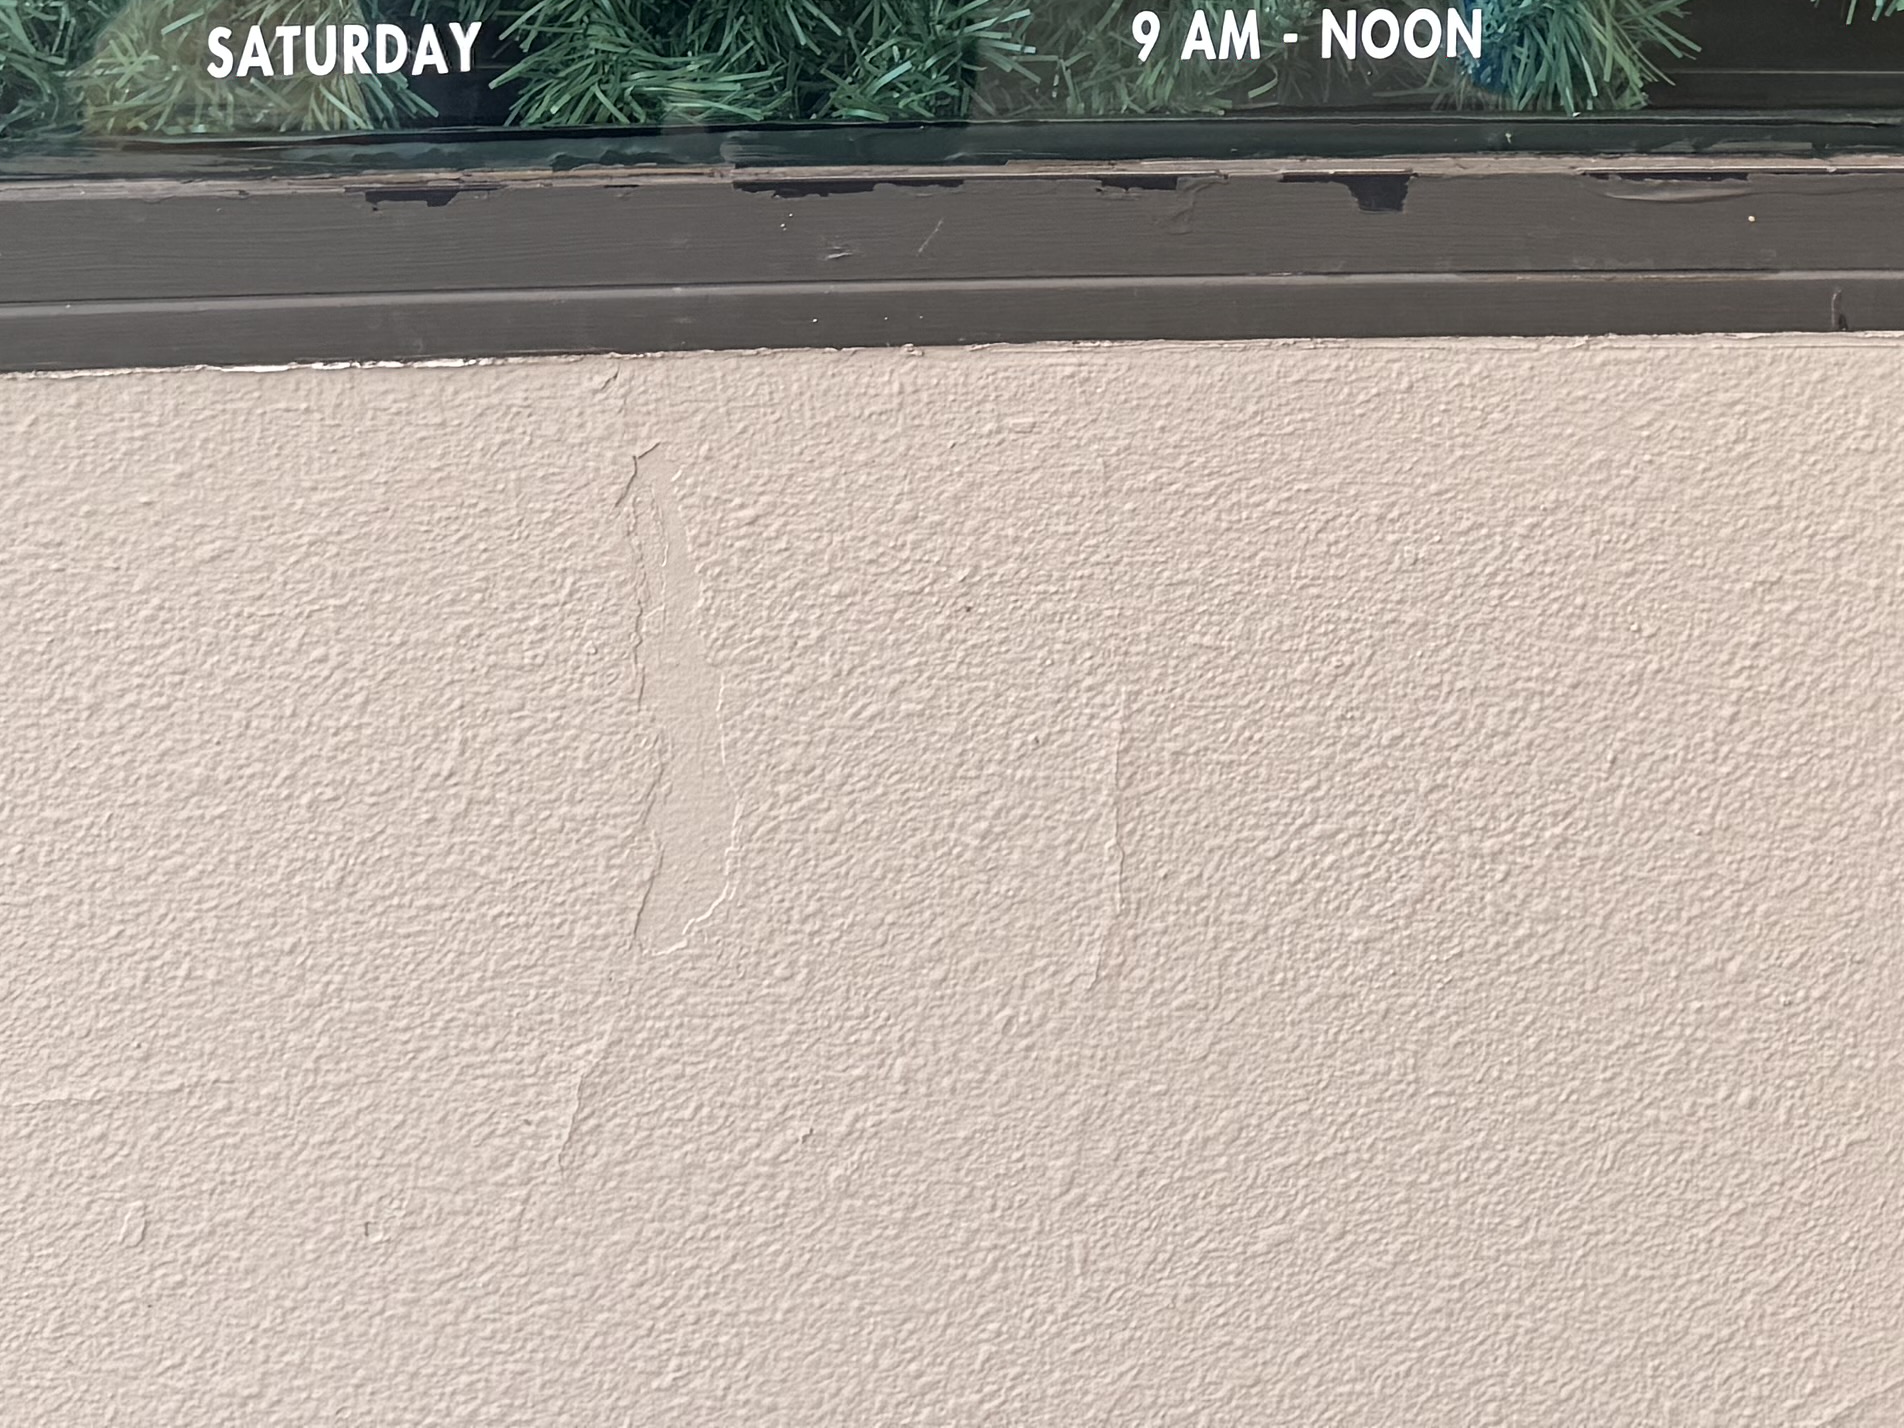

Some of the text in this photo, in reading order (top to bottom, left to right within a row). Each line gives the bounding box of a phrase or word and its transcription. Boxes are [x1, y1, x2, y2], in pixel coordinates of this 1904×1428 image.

[205, 20, 483, 80] SATURDAY
[1131, 9, 1162, 63] 9
[1179, 8, 1262, 61] AM
[1320, 6, 1483, 61] NOON
